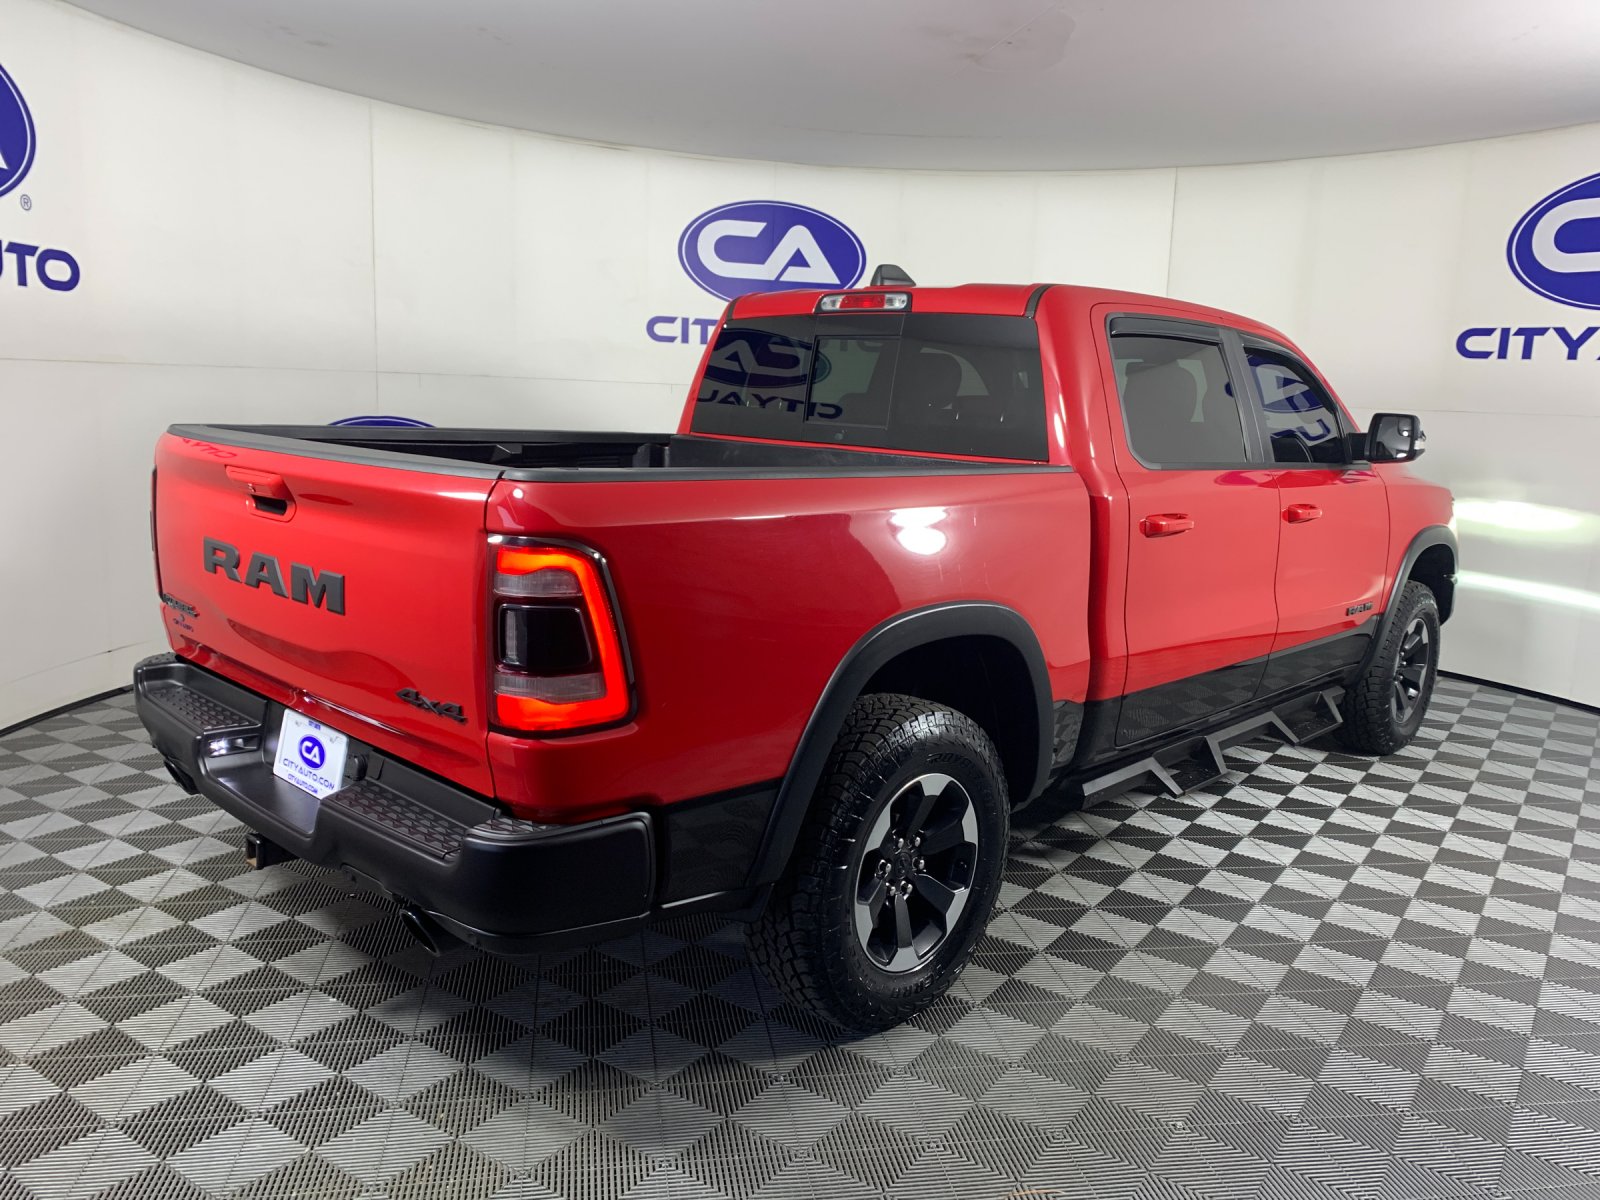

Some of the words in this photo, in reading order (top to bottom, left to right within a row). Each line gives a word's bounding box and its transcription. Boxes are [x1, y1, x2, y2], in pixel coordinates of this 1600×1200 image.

[0, 240, 80, 292] TO
[697, 219, 841, 284] CA
[1456, 326, 1600, 361] CITY
[203, 536, 346, 616] RAM
[301, 740, 321, 766] CA
